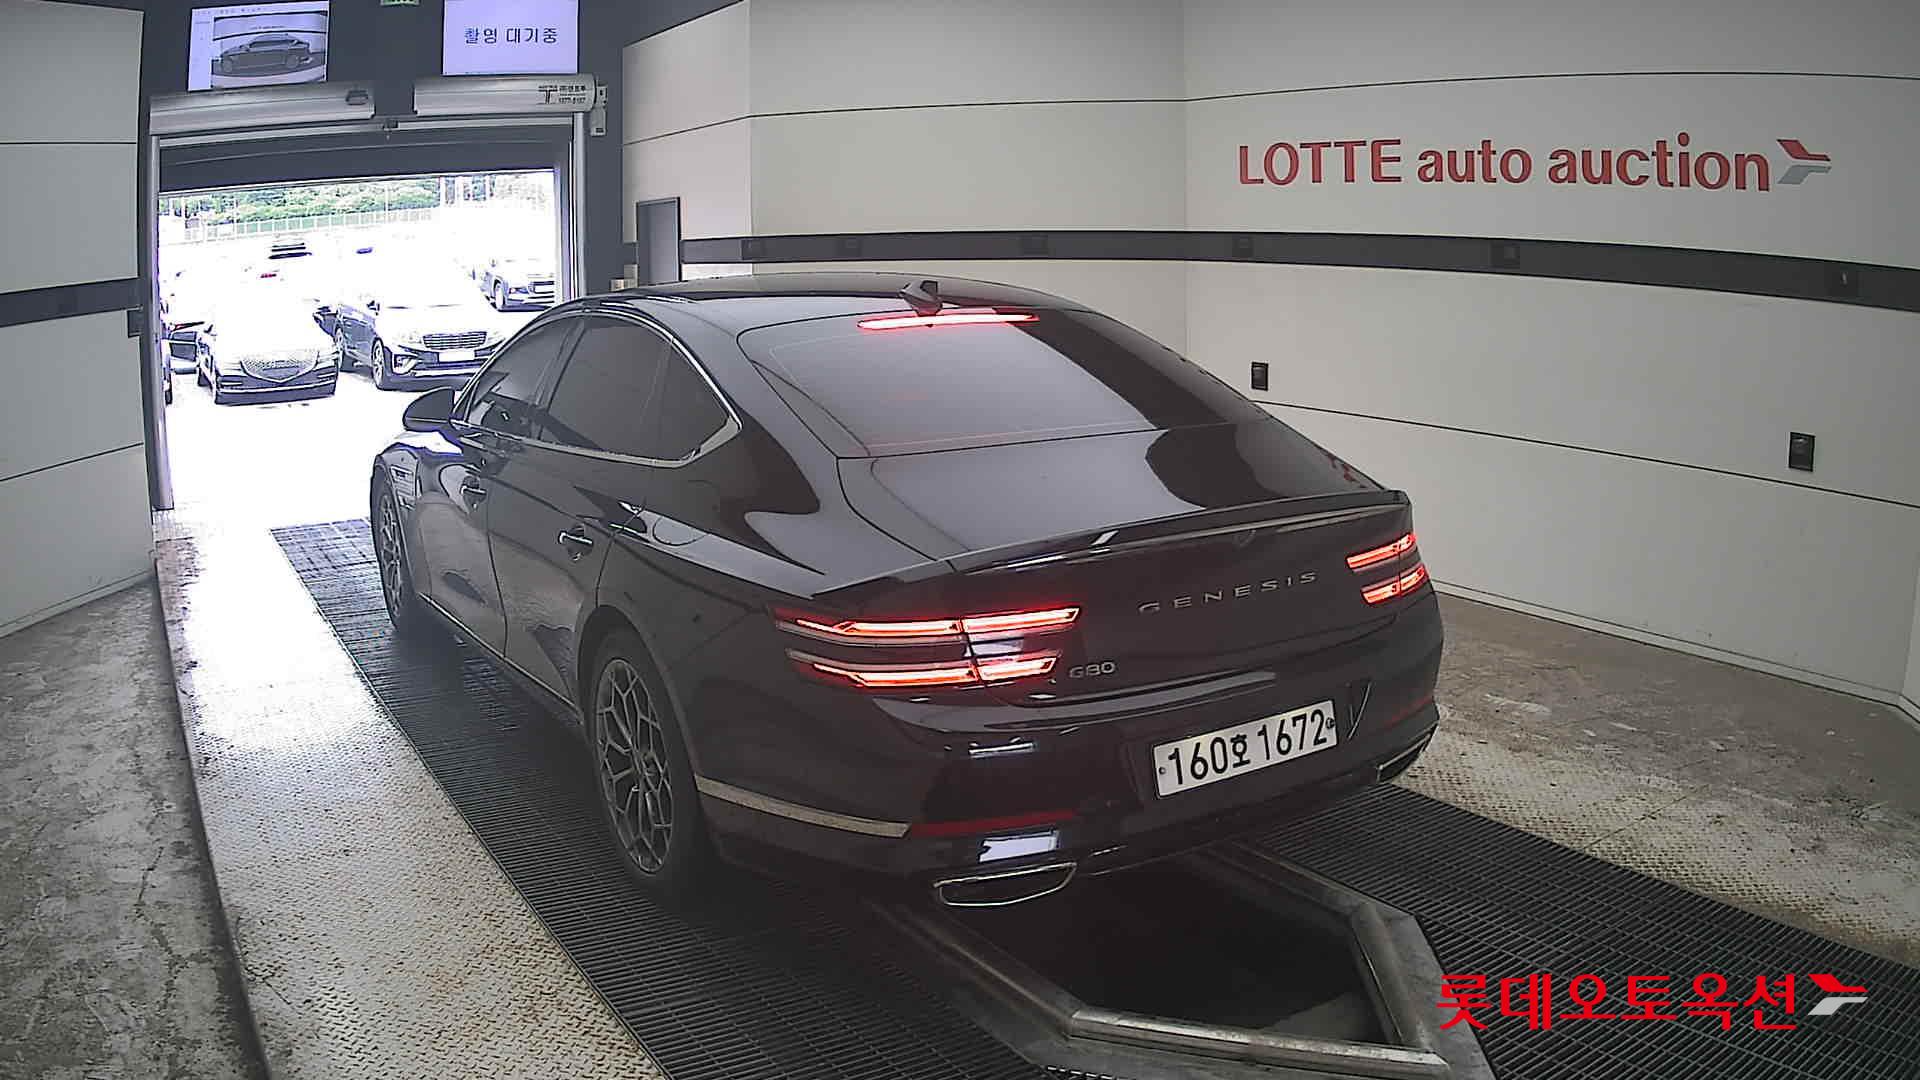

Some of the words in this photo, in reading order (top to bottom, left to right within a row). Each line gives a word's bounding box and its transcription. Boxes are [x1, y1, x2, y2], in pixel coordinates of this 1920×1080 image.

[506, 27, 558, 44] 대기중
[1239, 138, 1402, 185] LOTTE
[1417, 139, 1532, 183] auto
[1548, 132, 1770, 191] auction
[1138, 571, 1317, 614] GENESIS
[1068, 660, 1117, 679] G80
[1257, 708, 1328, 761] 1672
